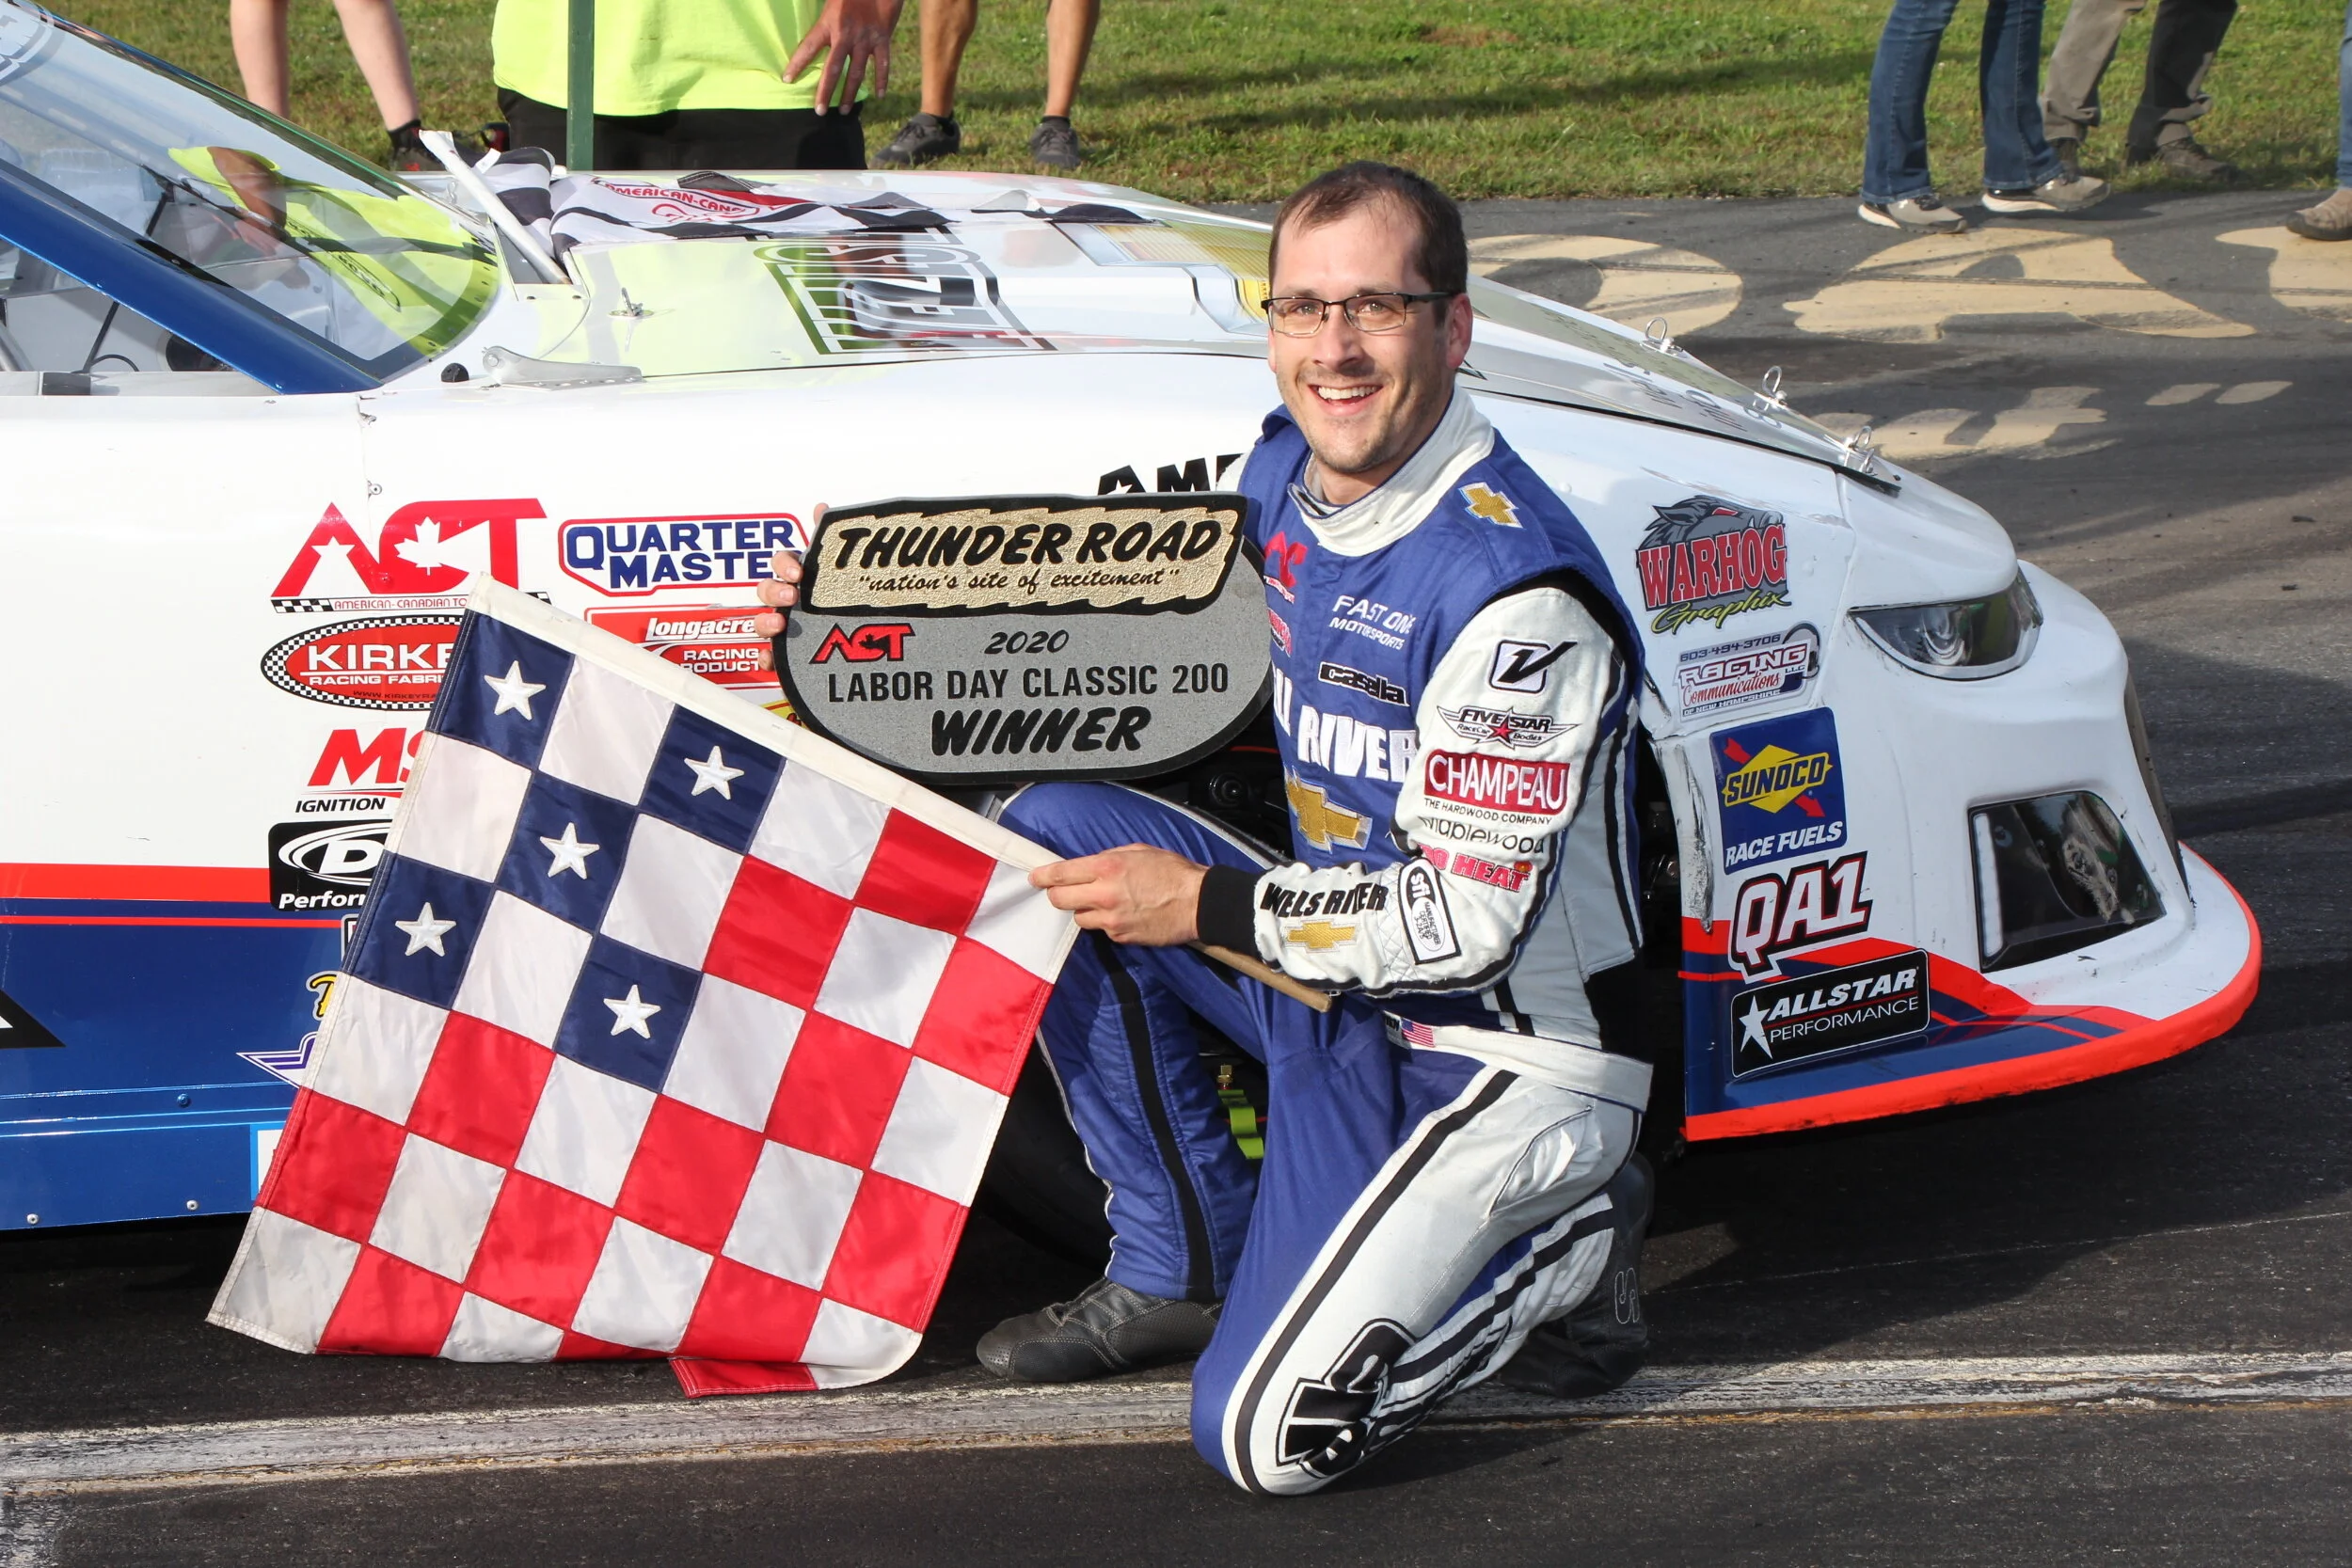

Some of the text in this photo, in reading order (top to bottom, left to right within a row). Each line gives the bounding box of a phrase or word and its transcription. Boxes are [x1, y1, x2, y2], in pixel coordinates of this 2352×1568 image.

[271, 498, 548, 597] ACT
[566, 520, 795, 570] QUARTER
[834, 520, 1222, 569] THUNDER ROAD
[610, 550, 803, 590] MASTE
[968, 572, 1007, 589] site
[1018, 569, 1041, 595] of
[1050, 569, 1180, 587] excitement"
[1637, 525, 1788, 609] WARHOG
[334, 597, 452, 610] AMERICAN-CANADIAN
[1332, 594, 1389, 623] FAST
[1650, 589, 1792, 635] Graphix
[684, 648, 759, 661] RACING
[809, 622, 1070, 665] ACT 2020
[310, 674, 444, 686] RACING FABRI
[829, 662, 1229, 703] LABOR DAY CLASSIC 200
[1679, 643, 1807, 689] RACING LLC
[1683, 671, 1781, 707] Communications
[1696, 703, 1718, 714] NEW
[931, 705, 1152, 756] WINNER
[1458, 708, 1551, 733] FIVE STAR
[1297, 705, 1417, 784] RIVER
[1428, 754, 1566, 810] CHAMPEAU
[1726, 755, 1826, 804] SUNOCO
[294, 798, 387, 814] IGNITION
[1424, 798, 1552, 826] THE HARDWOOD COMPANY
[1724, 820, 1844, 868] RACE FUELS
[1410, 872, 1432, 899] sfi
[1451, 852, 1531, 894] HEAT
[1734, 854, 1869, 969] QA1
[1767, 968, 1917, 1022] ALLSTAR
[1770, 995, 1920, 1044] PERFORMANCE
